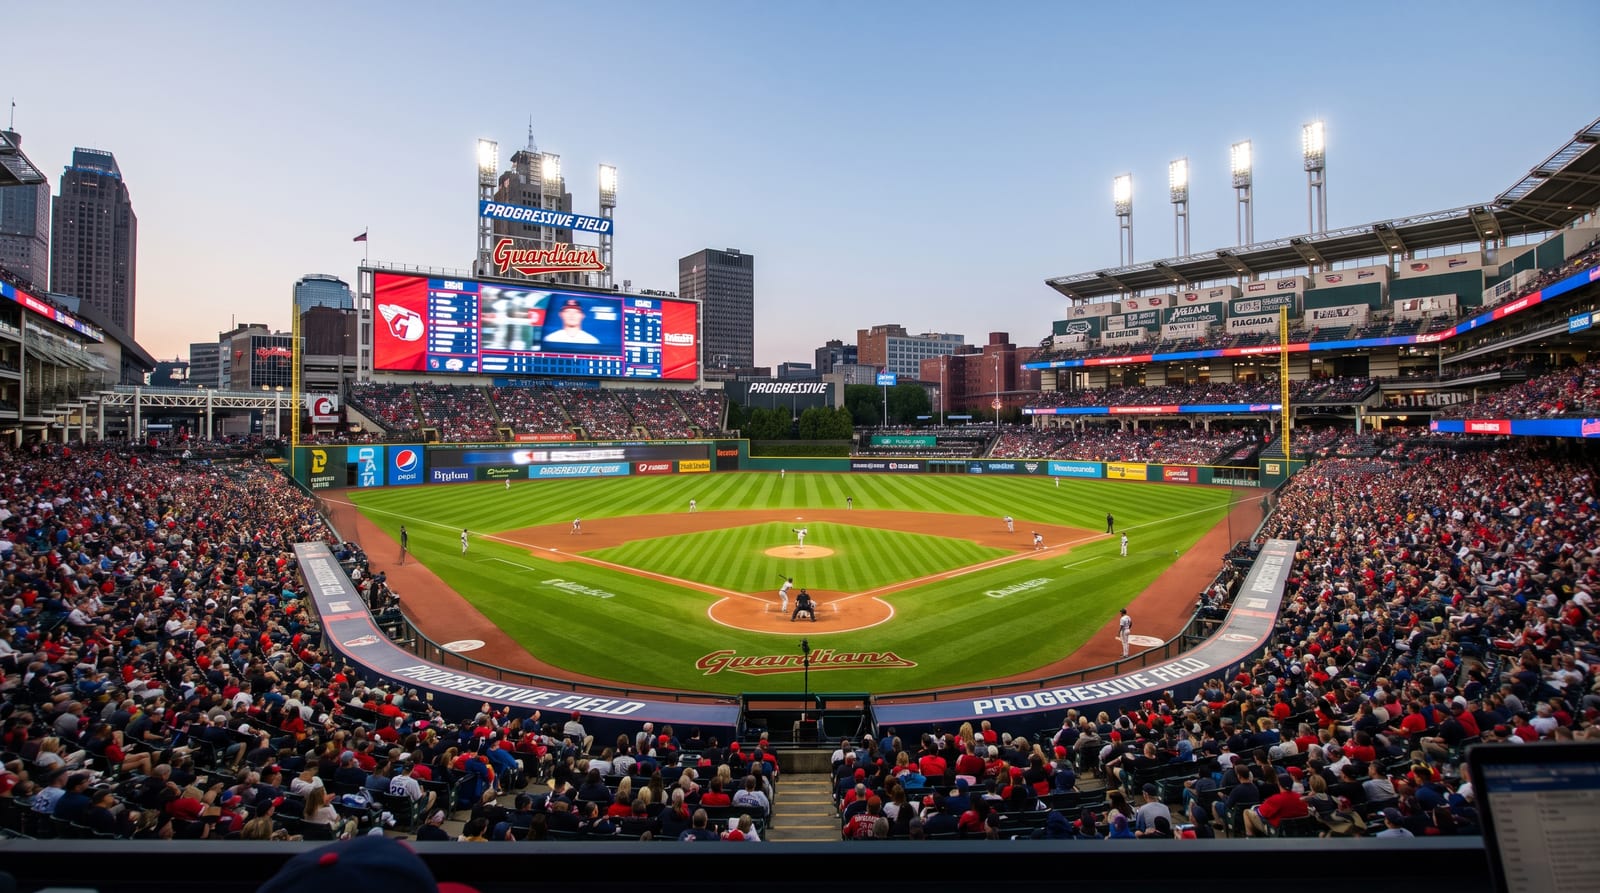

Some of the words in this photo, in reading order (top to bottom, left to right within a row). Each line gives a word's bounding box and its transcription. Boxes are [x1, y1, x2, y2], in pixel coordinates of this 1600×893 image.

[483, 203, 574, 227] PROGRESSIVE
[574, 216, 610, 232] FIELD
[493, 238, 605, 276] Guardians
[748, 382, 828, 394] PROGRESSIVE
[695, 649, 919, 676] Guardians
[395, 664, 561, 705] PROGRESSIVE
[546, 694, 646, 716] FIELD
[973, 673, 1157, 715] PROGRESSIVE
[1147, 657, 1211, 682] FIELD
